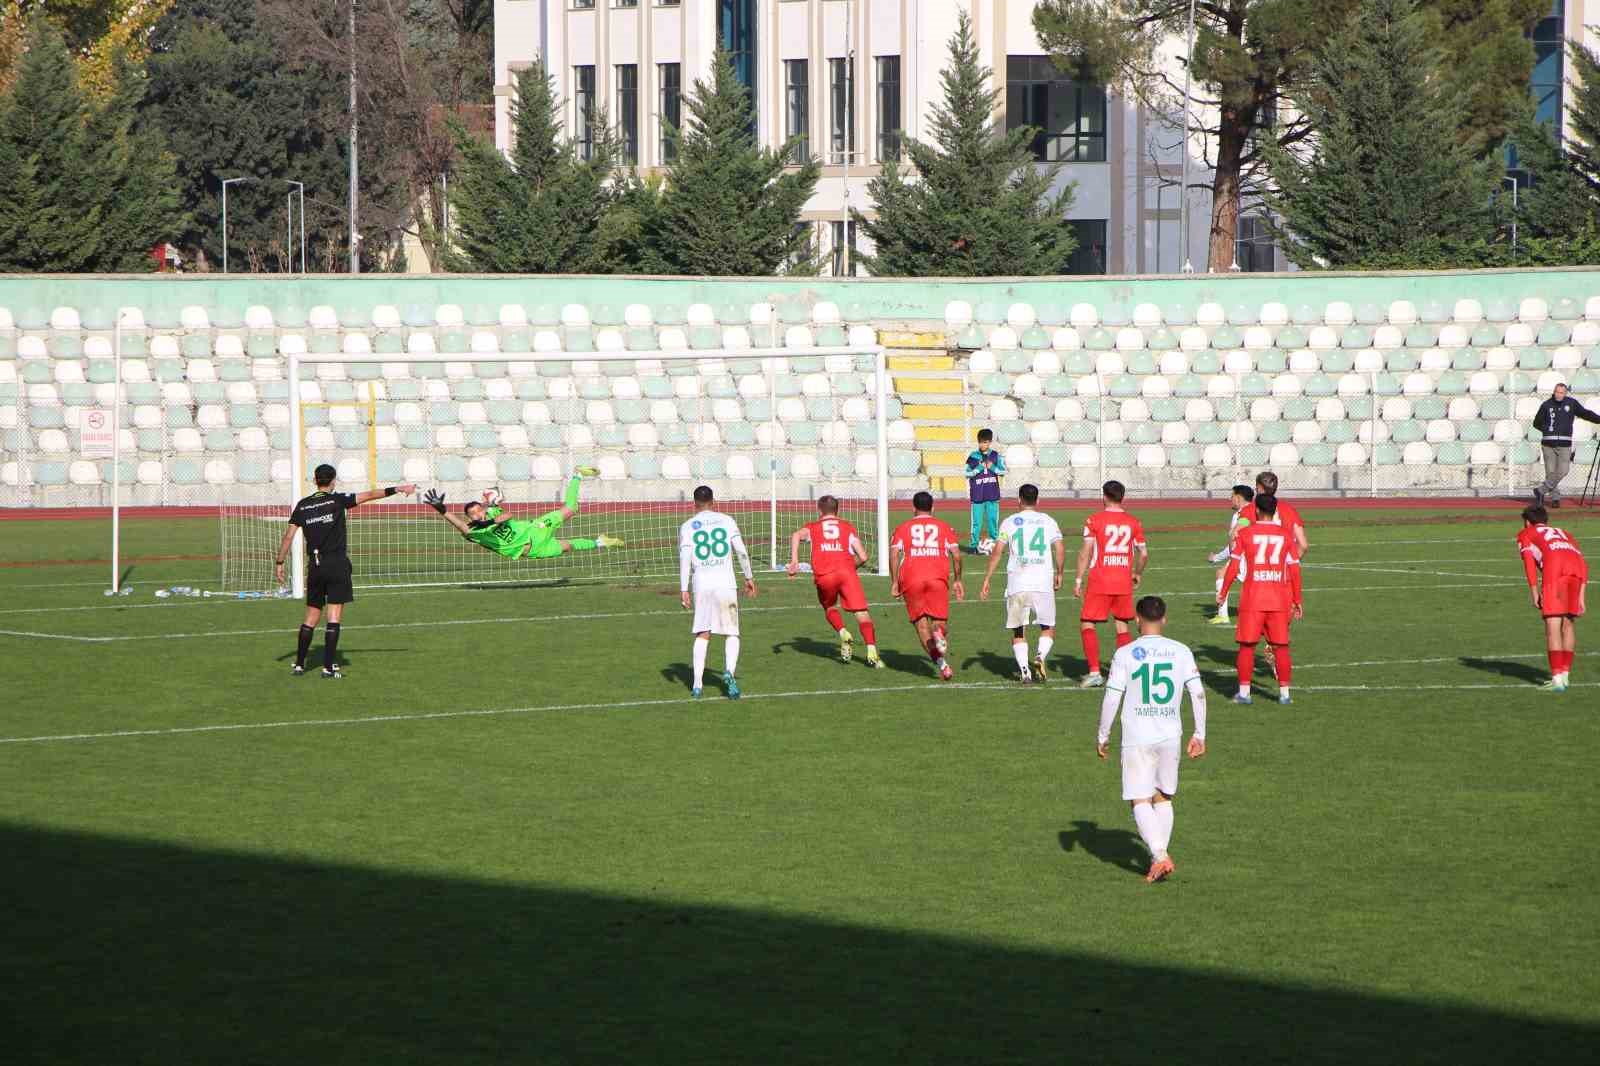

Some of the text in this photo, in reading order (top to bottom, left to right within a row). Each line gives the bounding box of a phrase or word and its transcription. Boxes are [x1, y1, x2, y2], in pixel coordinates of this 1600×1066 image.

[692, 527, 730, 561] 88
[821, 520, 840, 540] 5
[910, 524, 939, 548] 92
[1012, 527, 1047, 557] 14
[1104, 524, 1132, 554] 22
[1252, 534, 1285, 565] 77
[1131, 662, 1176, 705] 15
